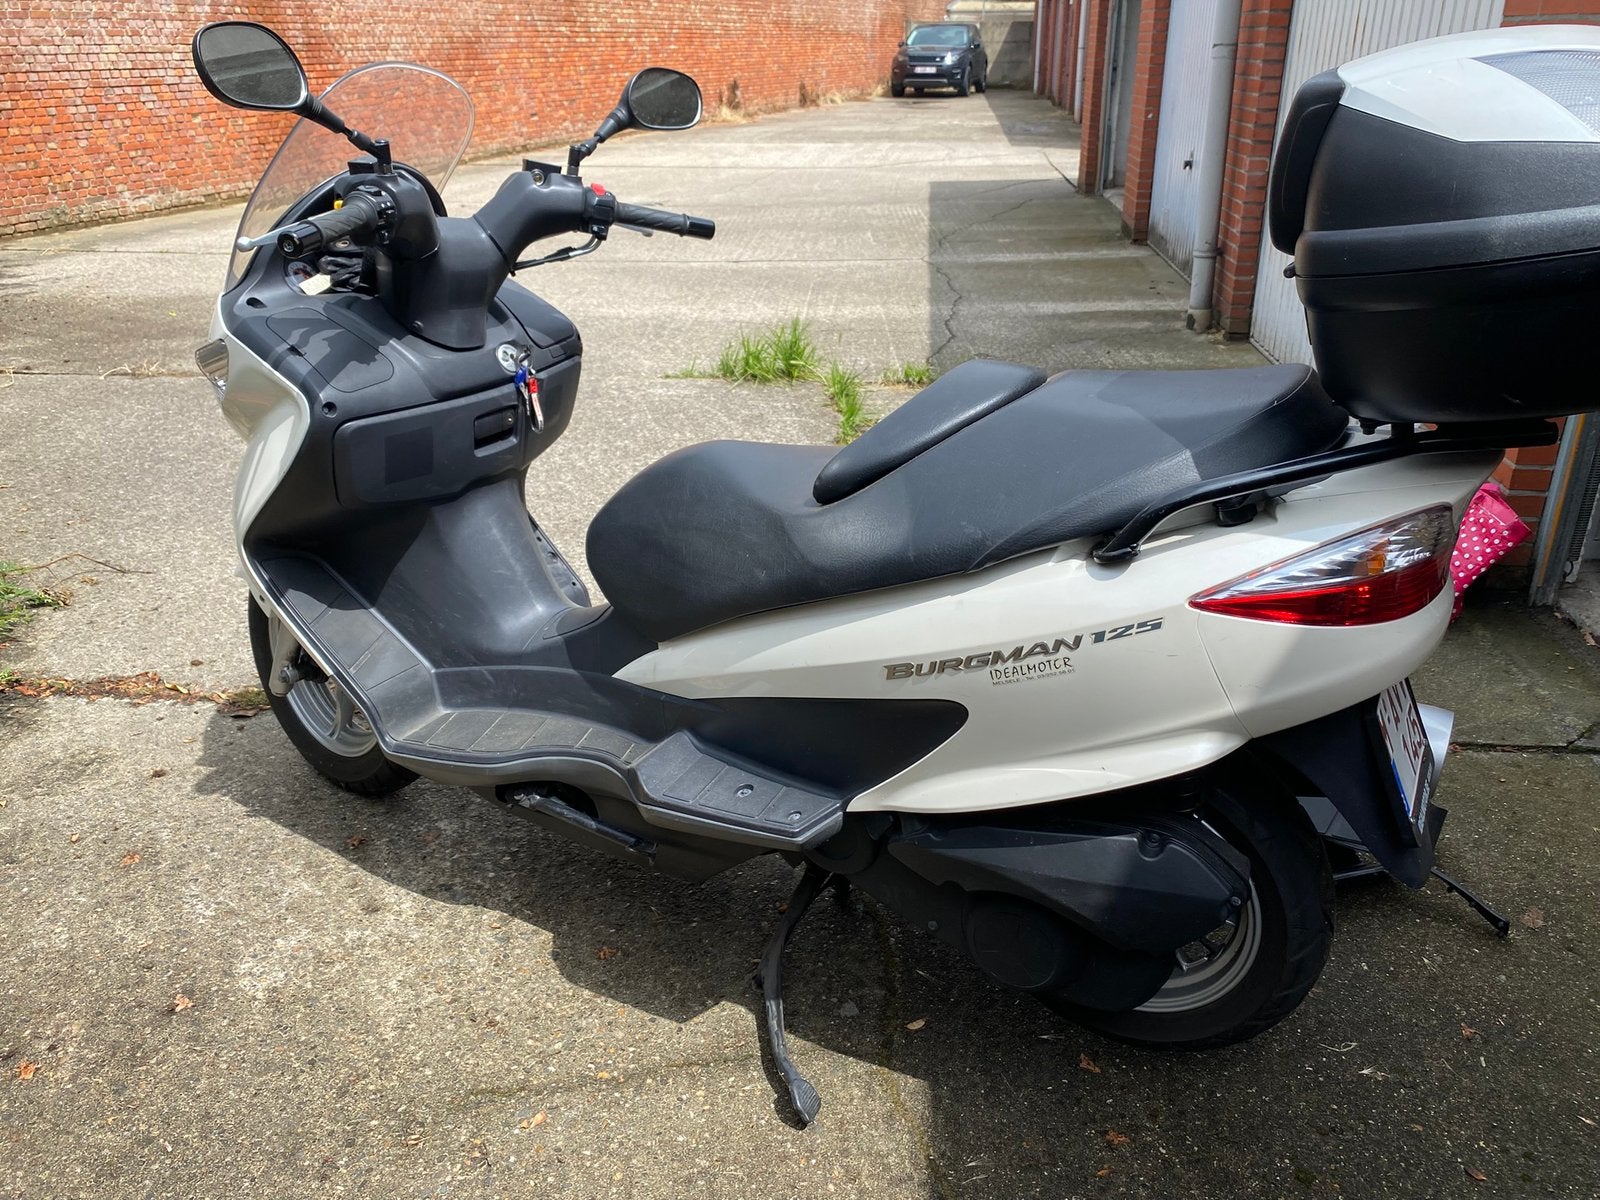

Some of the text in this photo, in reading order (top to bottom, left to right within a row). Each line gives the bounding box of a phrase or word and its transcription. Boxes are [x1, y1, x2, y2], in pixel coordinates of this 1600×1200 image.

[884, 617, 1164, 681] BURGMAN 125
[1402, 703, 1423, 776] 145
